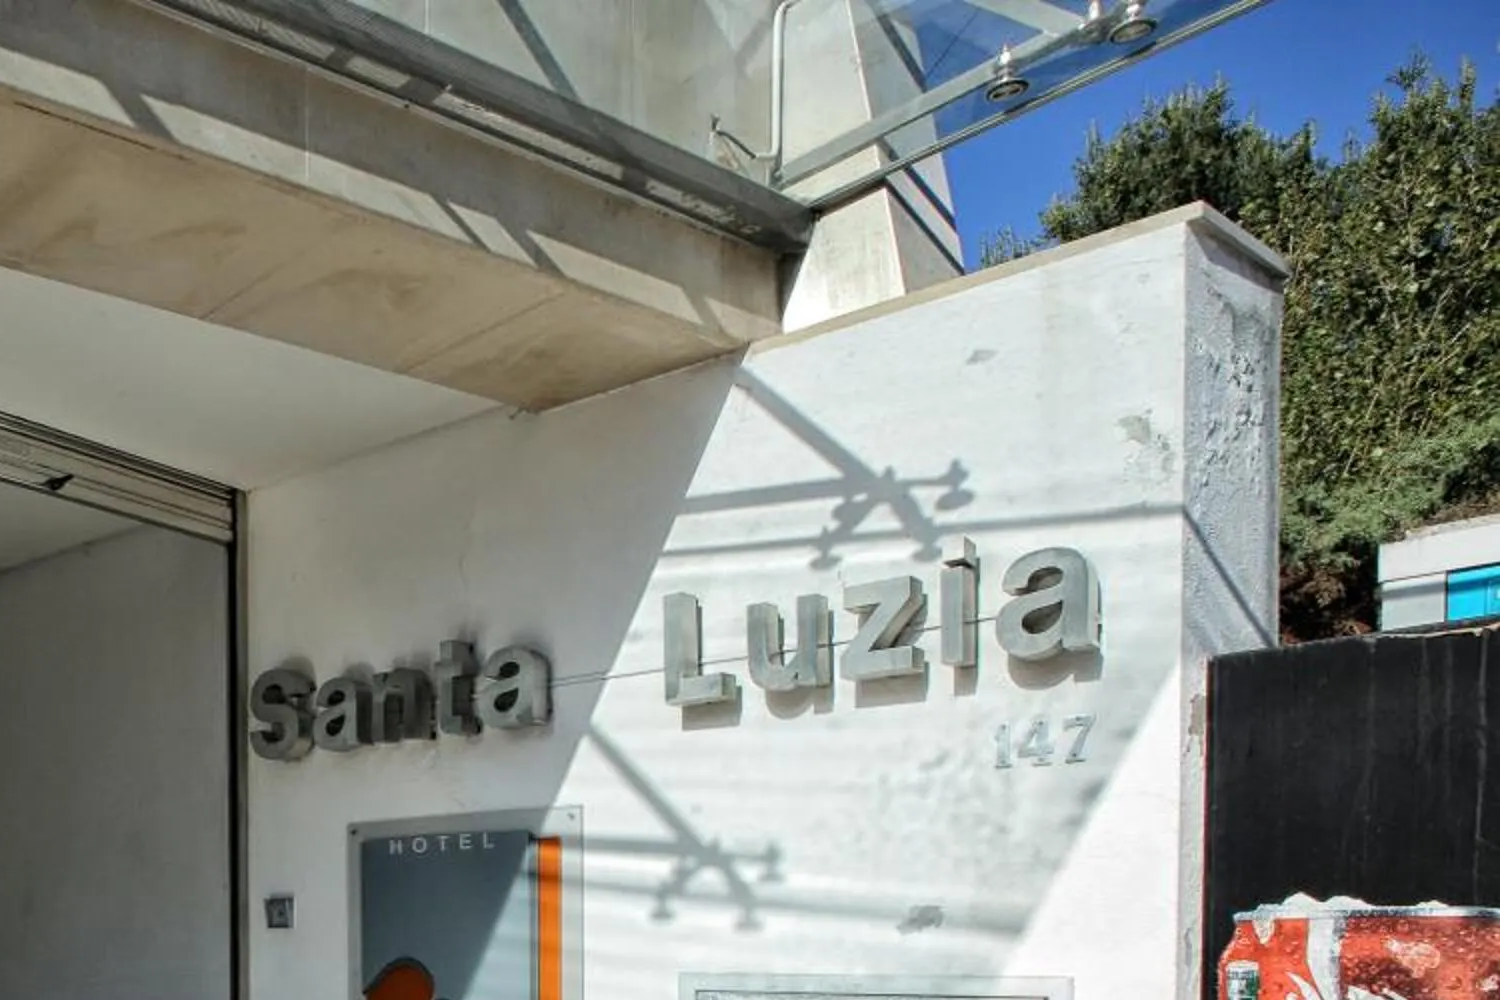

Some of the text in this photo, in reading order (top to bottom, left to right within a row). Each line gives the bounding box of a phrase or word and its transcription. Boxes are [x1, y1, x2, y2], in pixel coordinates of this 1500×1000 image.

[663, 535, 1101, 706] Luzia
[993, 712, 1097, 769] 147
[389, 831, 496, 855] HOTEL
